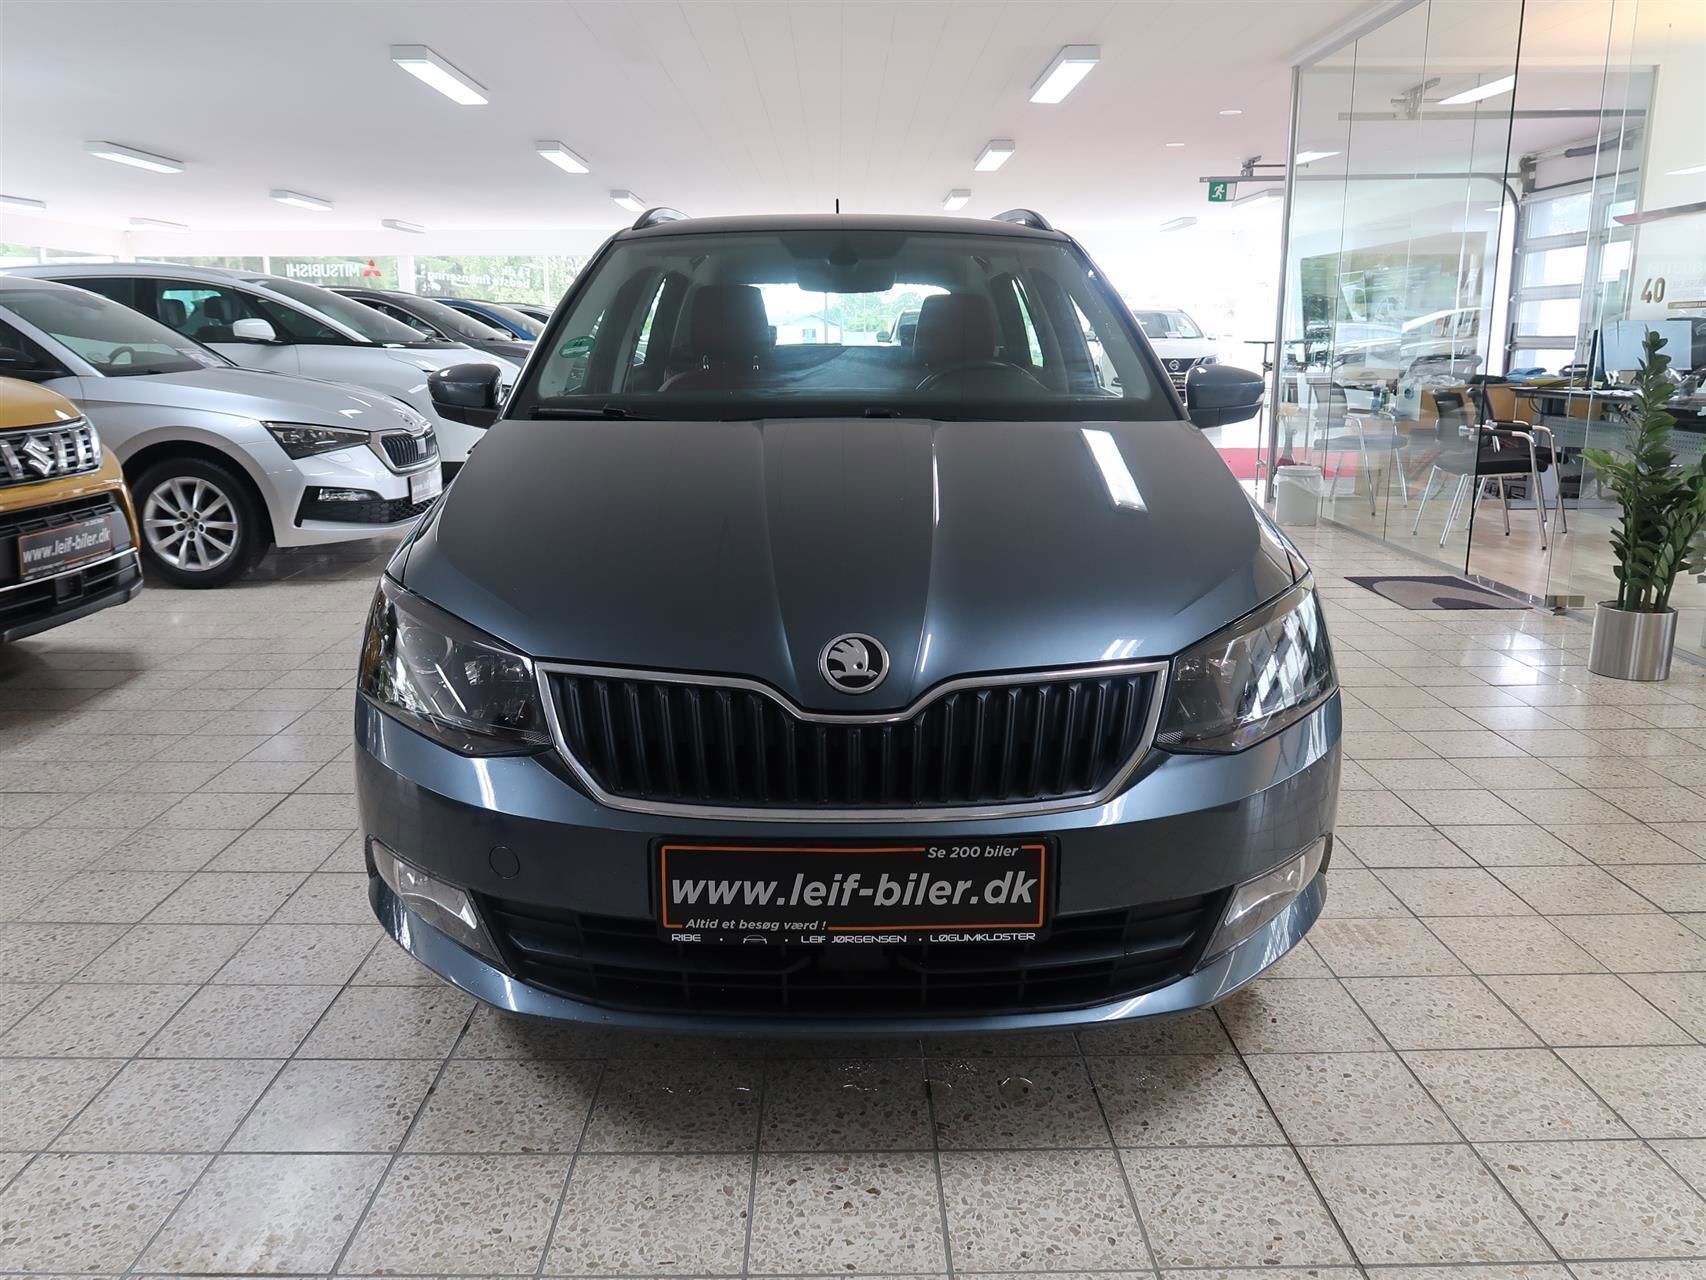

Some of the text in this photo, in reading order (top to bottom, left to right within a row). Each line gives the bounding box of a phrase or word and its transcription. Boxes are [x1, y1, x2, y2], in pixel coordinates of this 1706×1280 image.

[1640, 277, 1666, 303] 40
[23, 528, 110, 563] www.leif-biler.dk
[927, 845, 1019, 859] Se 200 biler
[672, 871, 1038, 906] www.leif-biler.dk
[685, 918, 719, 929] Altid
[721, 919, 736, 929] et
[738, 919, 780, 932] besøg
[783, 920, 819, 931] værd
[671, 932, 1036, 944] RIBE LEIF JØRGENSEN LØGUMKLOSTER
